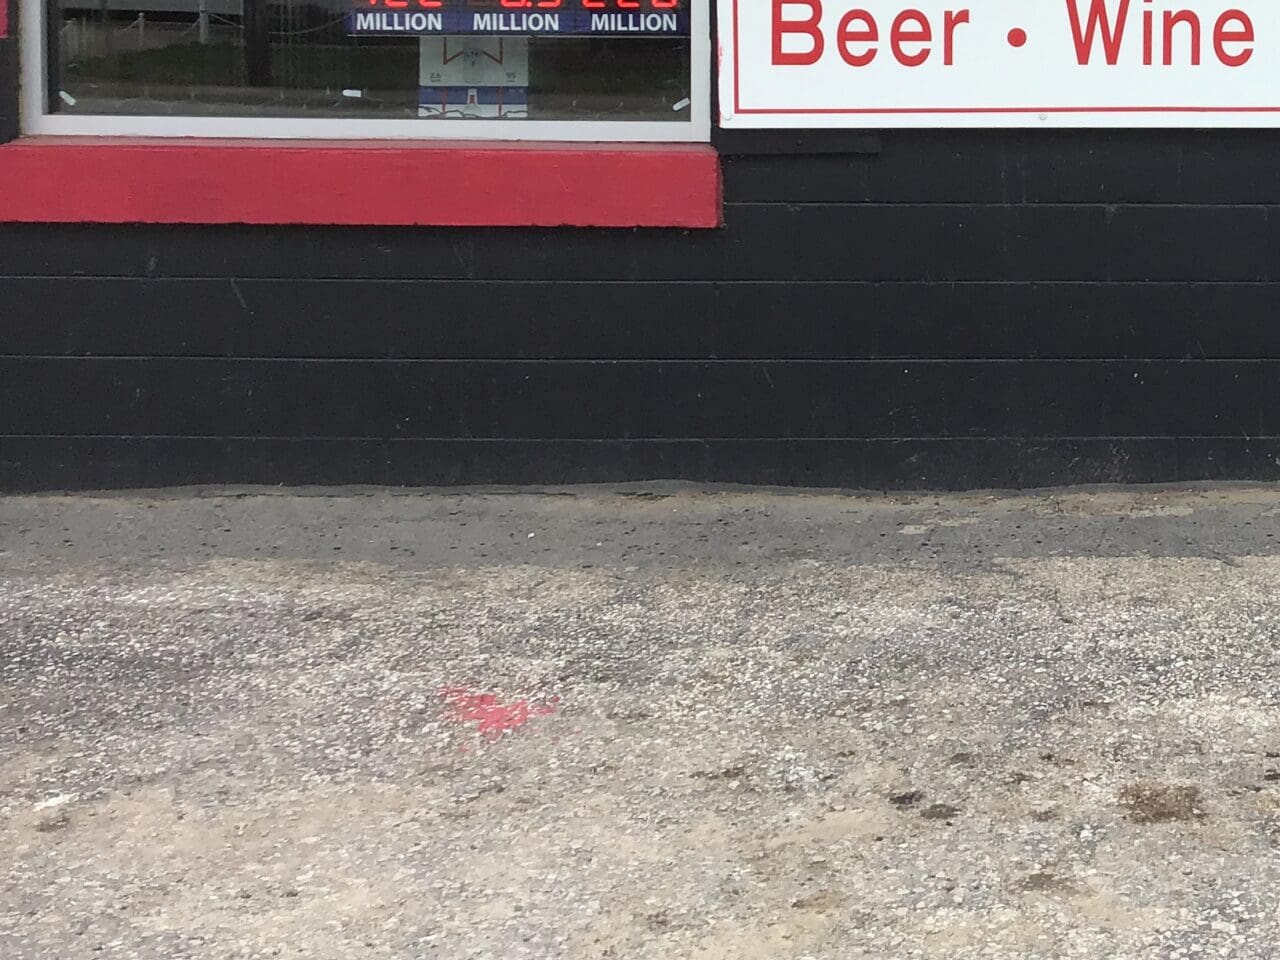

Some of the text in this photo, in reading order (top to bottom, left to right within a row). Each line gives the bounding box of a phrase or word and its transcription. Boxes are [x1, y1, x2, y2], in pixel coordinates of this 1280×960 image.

[356, 13, 442, 31] MILLION
[473, 13, 559, 31] MILLION
[591, 13, 677, 31] MILLION
